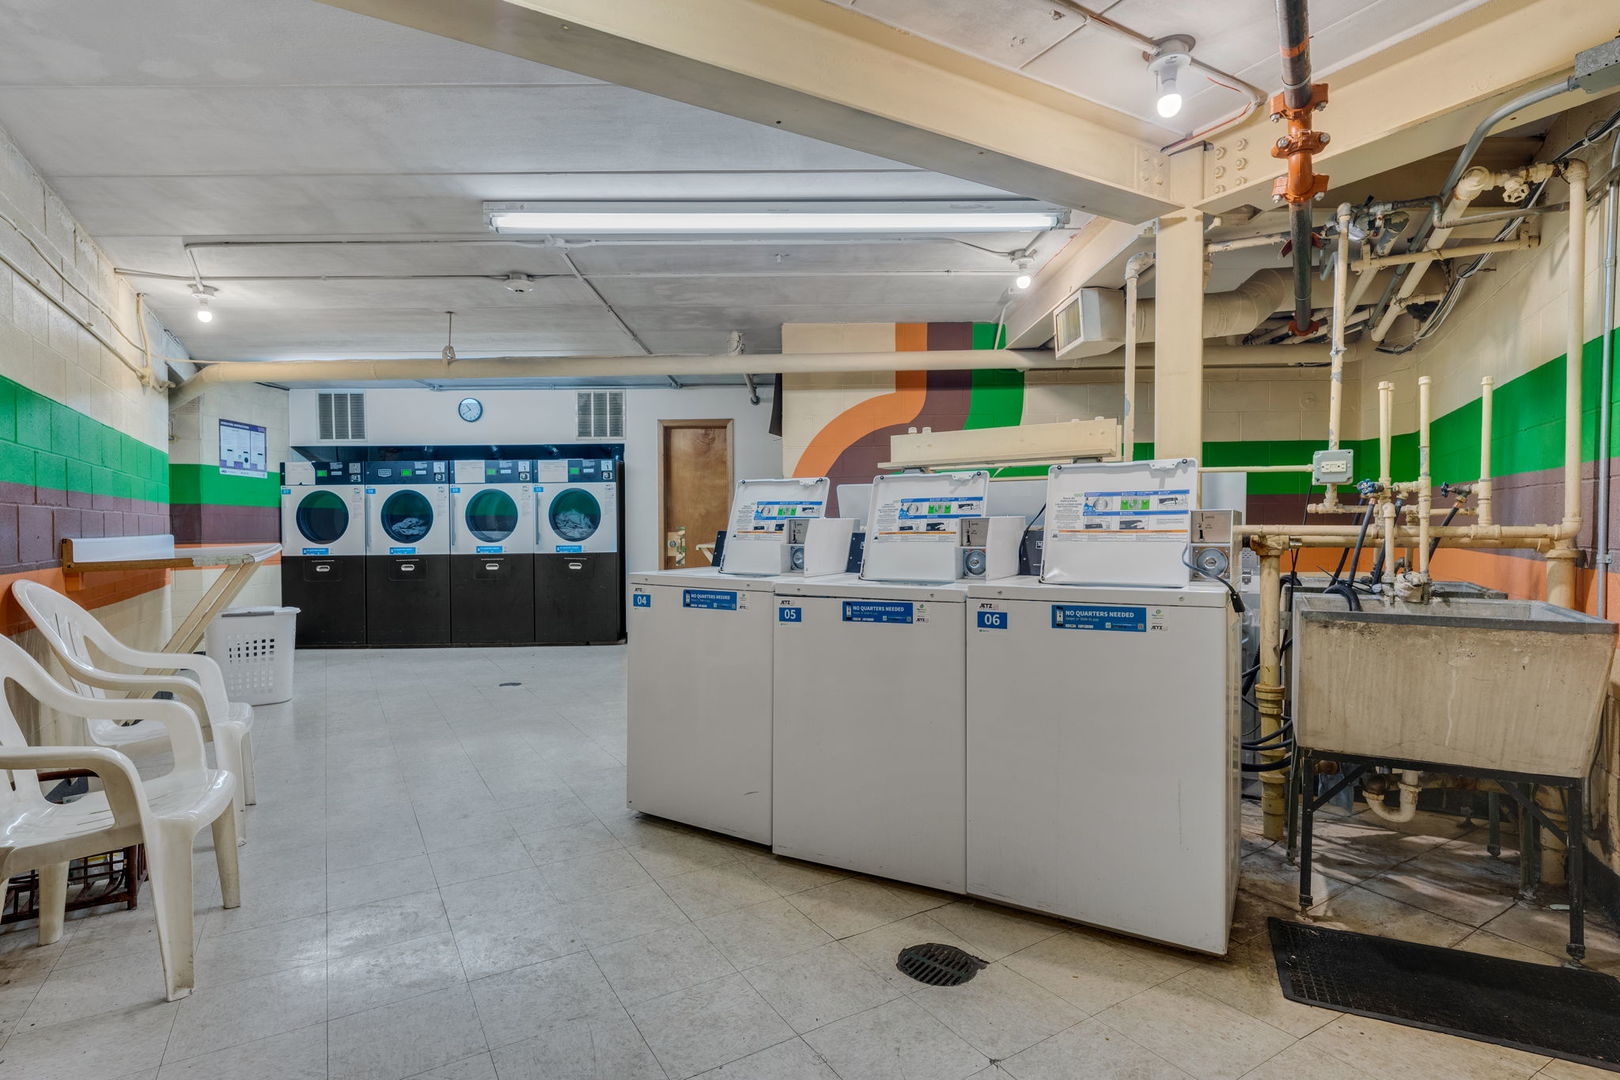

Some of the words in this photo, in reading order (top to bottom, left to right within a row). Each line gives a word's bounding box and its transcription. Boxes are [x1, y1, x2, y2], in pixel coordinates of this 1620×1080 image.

[637, 595, 647, 605] 04
[784, 609, 796, 620] 05
[984, 614, 1000, 626] 06
